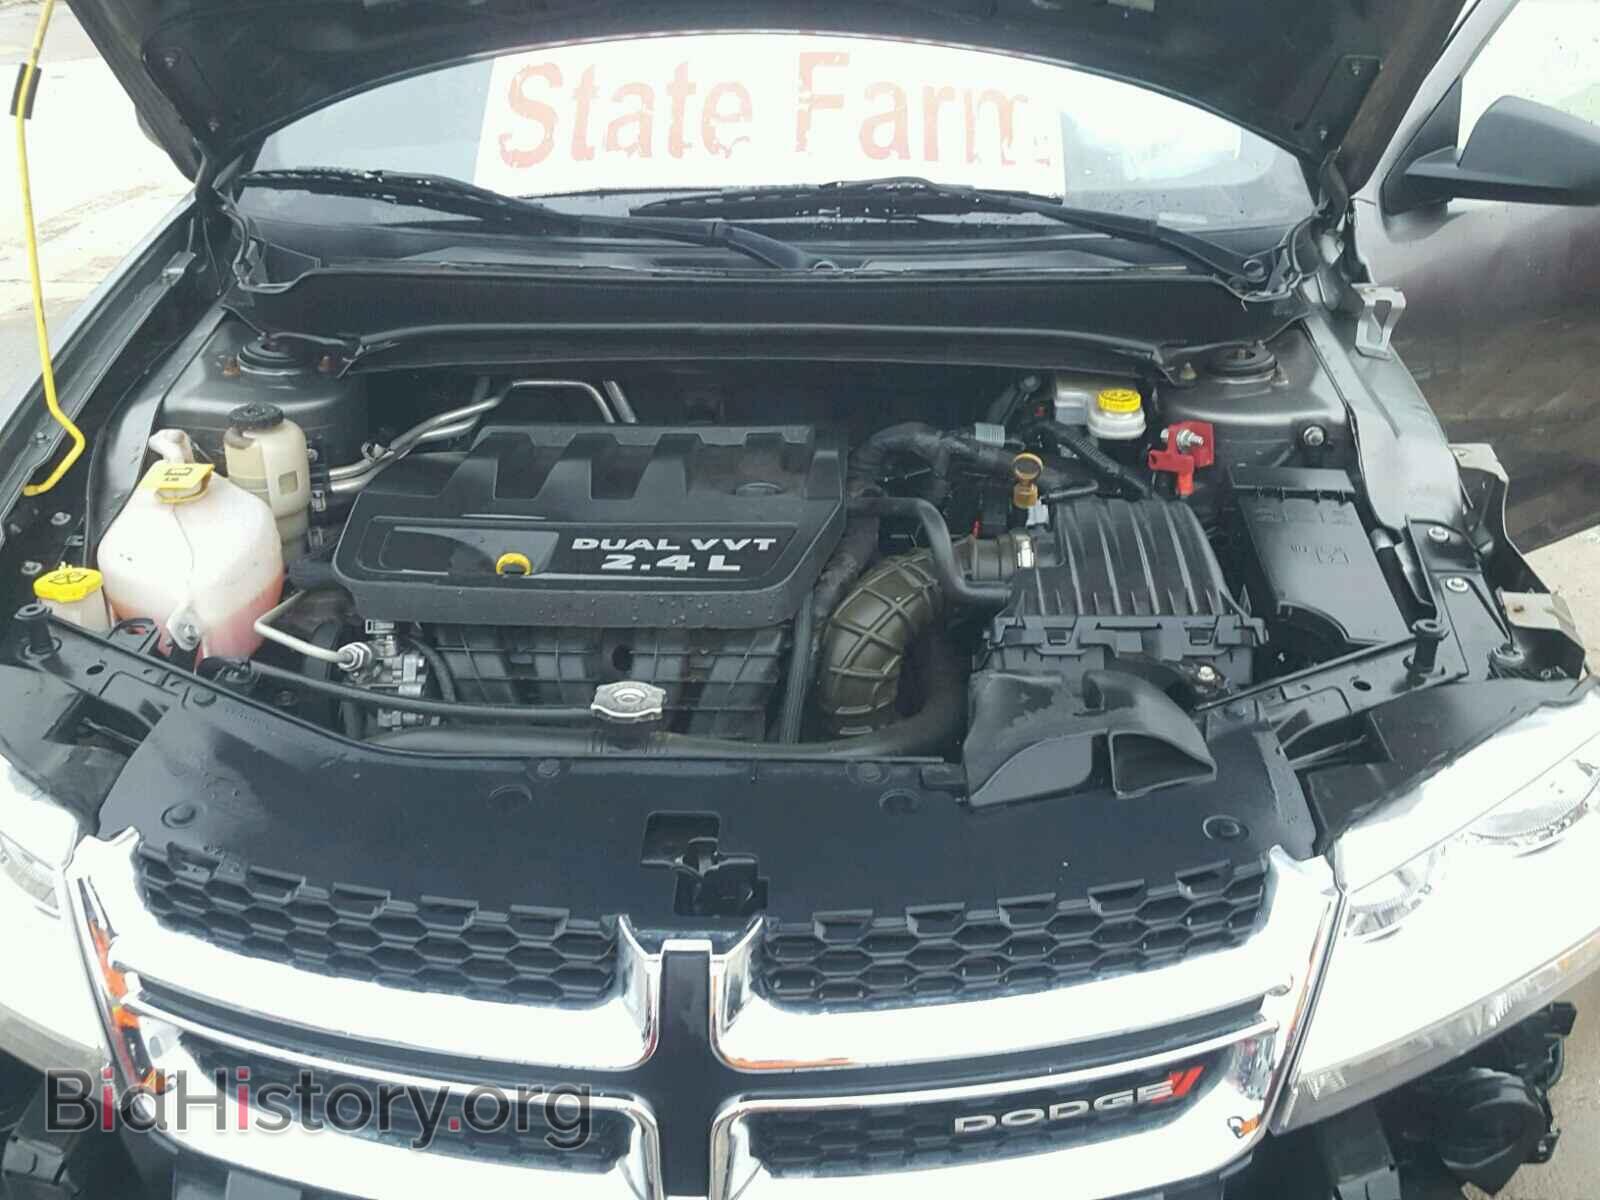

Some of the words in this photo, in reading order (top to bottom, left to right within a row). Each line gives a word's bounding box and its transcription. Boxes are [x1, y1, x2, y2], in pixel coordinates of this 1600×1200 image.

[499, 61, 753, 169] State
[571, 538, 681, 551] DUAL
[691, 538, 777, 551] VVT
[954, 1080, 1174, 1133] DODGE
